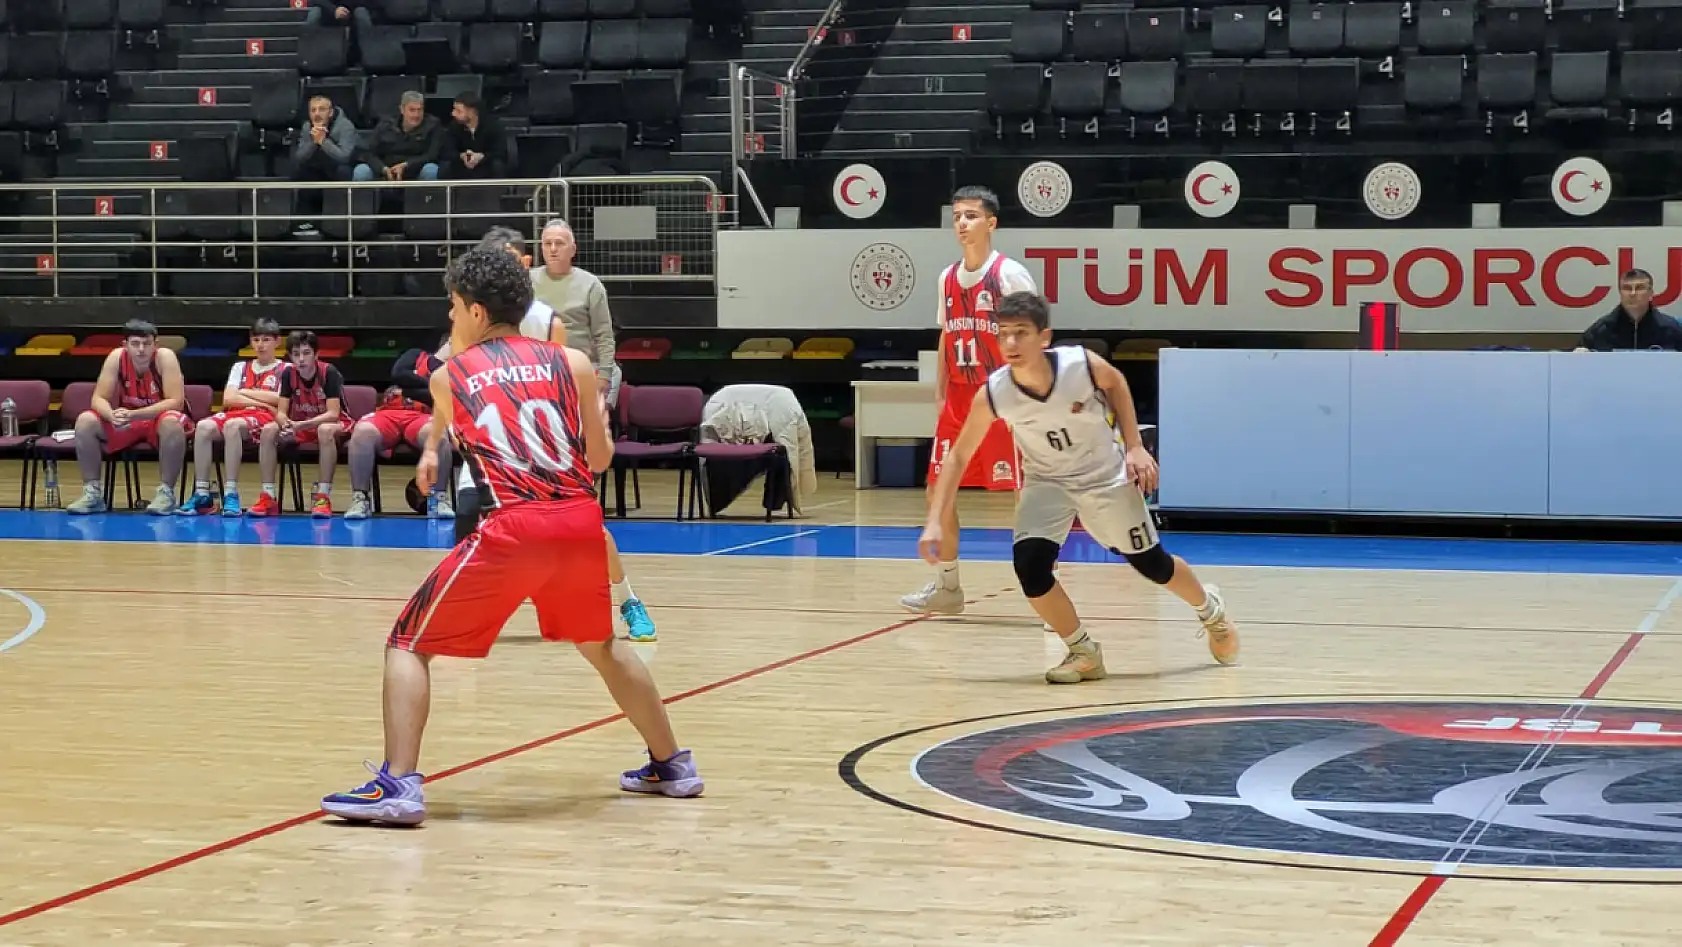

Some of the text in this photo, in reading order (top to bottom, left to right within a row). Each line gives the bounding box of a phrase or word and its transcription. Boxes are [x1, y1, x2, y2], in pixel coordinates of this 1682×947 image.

[957, 28, 966, 41] 4
[251, 42, 260, 55] 5
[203, 90, 211, 103] 4
[154, 144, 163, 159] 3
[100, 200, 109, 215] 2
[43, 259, 50, 270] 1
[1025, 248, 1228, 306] TÜM
[975, 318, 1000, 335] 1919
[954, 337, 982, 367] 11
[466, 363, 553, 396] EYMEN
[474, 399, 574, 473] 10
[1046, 427, 1073, 452] 61
[1129, 521, 1153, 550] 61
